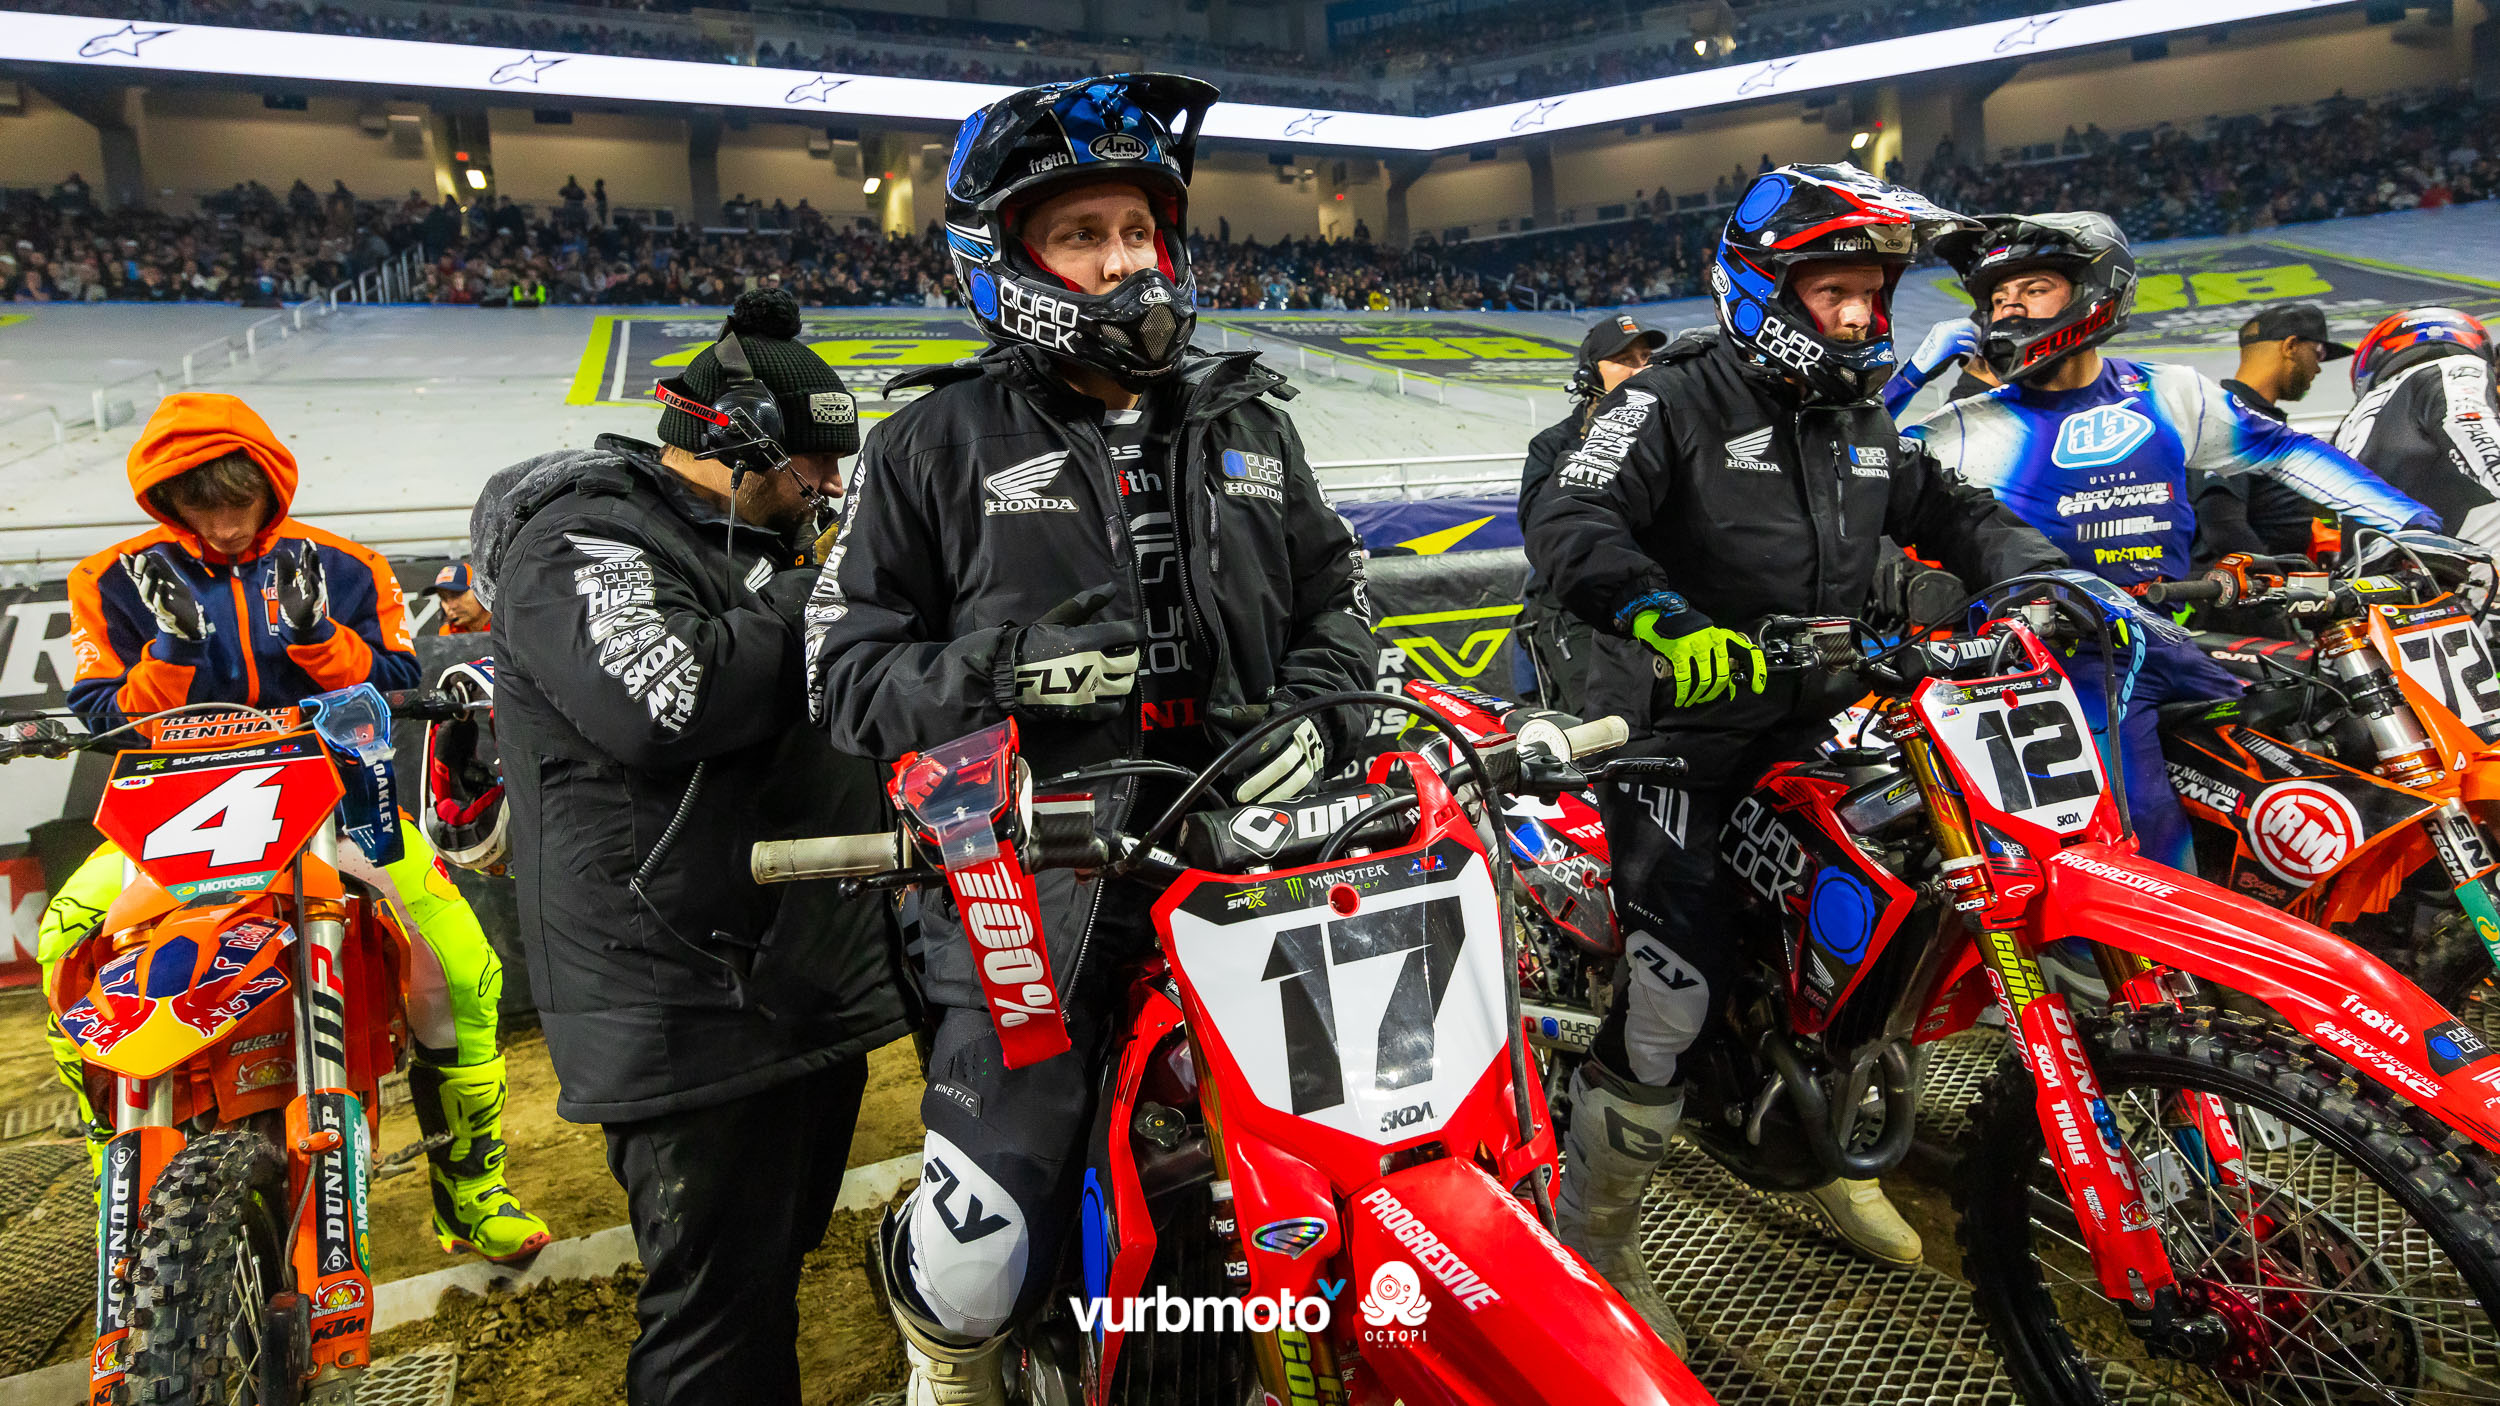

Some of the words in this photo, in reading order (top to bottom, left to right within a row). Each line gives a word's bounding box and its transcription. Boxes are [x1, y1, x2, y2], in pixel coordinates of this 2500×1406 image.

[1100, 136, 1142, 154] Arai
[1029, 151, 1069, 174] froth
[1833, 238, 1872, 252] froth
[999, 281, 1079, 329] QUAD
[1000, 312, 1076, 354] LOCK
[1763, 316, 1824, 362] QUAD
[1755, 329, 1816, 376] LOCK
[664, 393, 719, 421] ALEXANDER
[1245, 454, 1283, 472] QUAD
[1249, 467, 1284, 486] LOCK
[1727, 458, 1781, 473] HONDA
[1851, 466, 1889, 479] HONDA
[2090, 471, 2136, 485] ULTRA
[987, 498, 1078, 512] HONDA
[1226, 482, 1283, 503] HONDA
[2075, 489, 2111, 501] ROCKY
[2113, 482, 2167, 497] MOUNTAIN
[576, 560, 649, 578] HONDA
[603, 571, 651, 584] QUAD
[588, 587, 654, 617] HGS
[2288, 600, 2325, 613] ASV
[623, 635, 688, 695] SKDA
[2399, 627, 2500, 714] 72
[1014, 664, 1095, 698] FLY
[160, 717, 291, 742] RENTHAL
[172, 748, 266, 766] SUPERCROSS
[1976, 700, 2101, 814] 12
[2181, 766, 2240, 798] MOUNTAIN
[373, 762, 394, 835] OAKLEY
[143, 766, 285, 868] 4
[1297, 794, 1377, 840] odi
[2057, 812, 2081, 828] SKDA
[1731, 796, 1806, 880] QUAD
[2265, 802, 2345, 867] RM
[198, 874, 266, 895] MOTOREX
[1308, 863, 1390, 889] MONSTER
[2049, 851, 2181, 898] PROGRESSIVE
[1628, 901, 1664, 926] KINETIC
[1633, 945, 1691, 990] FLY
[1261, 896, 1466, 1116] 17
[2341, 993, 2411, 1045] froth
[1560, 1019, 1599, 1037] QUAD
[2032, 1042, 2060, 1089] SKDA
[2338, 1027, 2378, 1052] ROCKY
[2376, 1048, 2444, 1092] MOUNTAIN
[934, 1082, 975, 1108] KINETIC
[1380, 1101, 1434, 1133] SKDA
[2051, 1099, 2090, 1166] THULE
[353, 1122, 370, 1231] MOTOREX
[925, 1156, 1012, 1244] FLY
[1361, 1187, 1501, 1312] PROGRESSIVE
[312, 1317, 367, 1344] KTM
